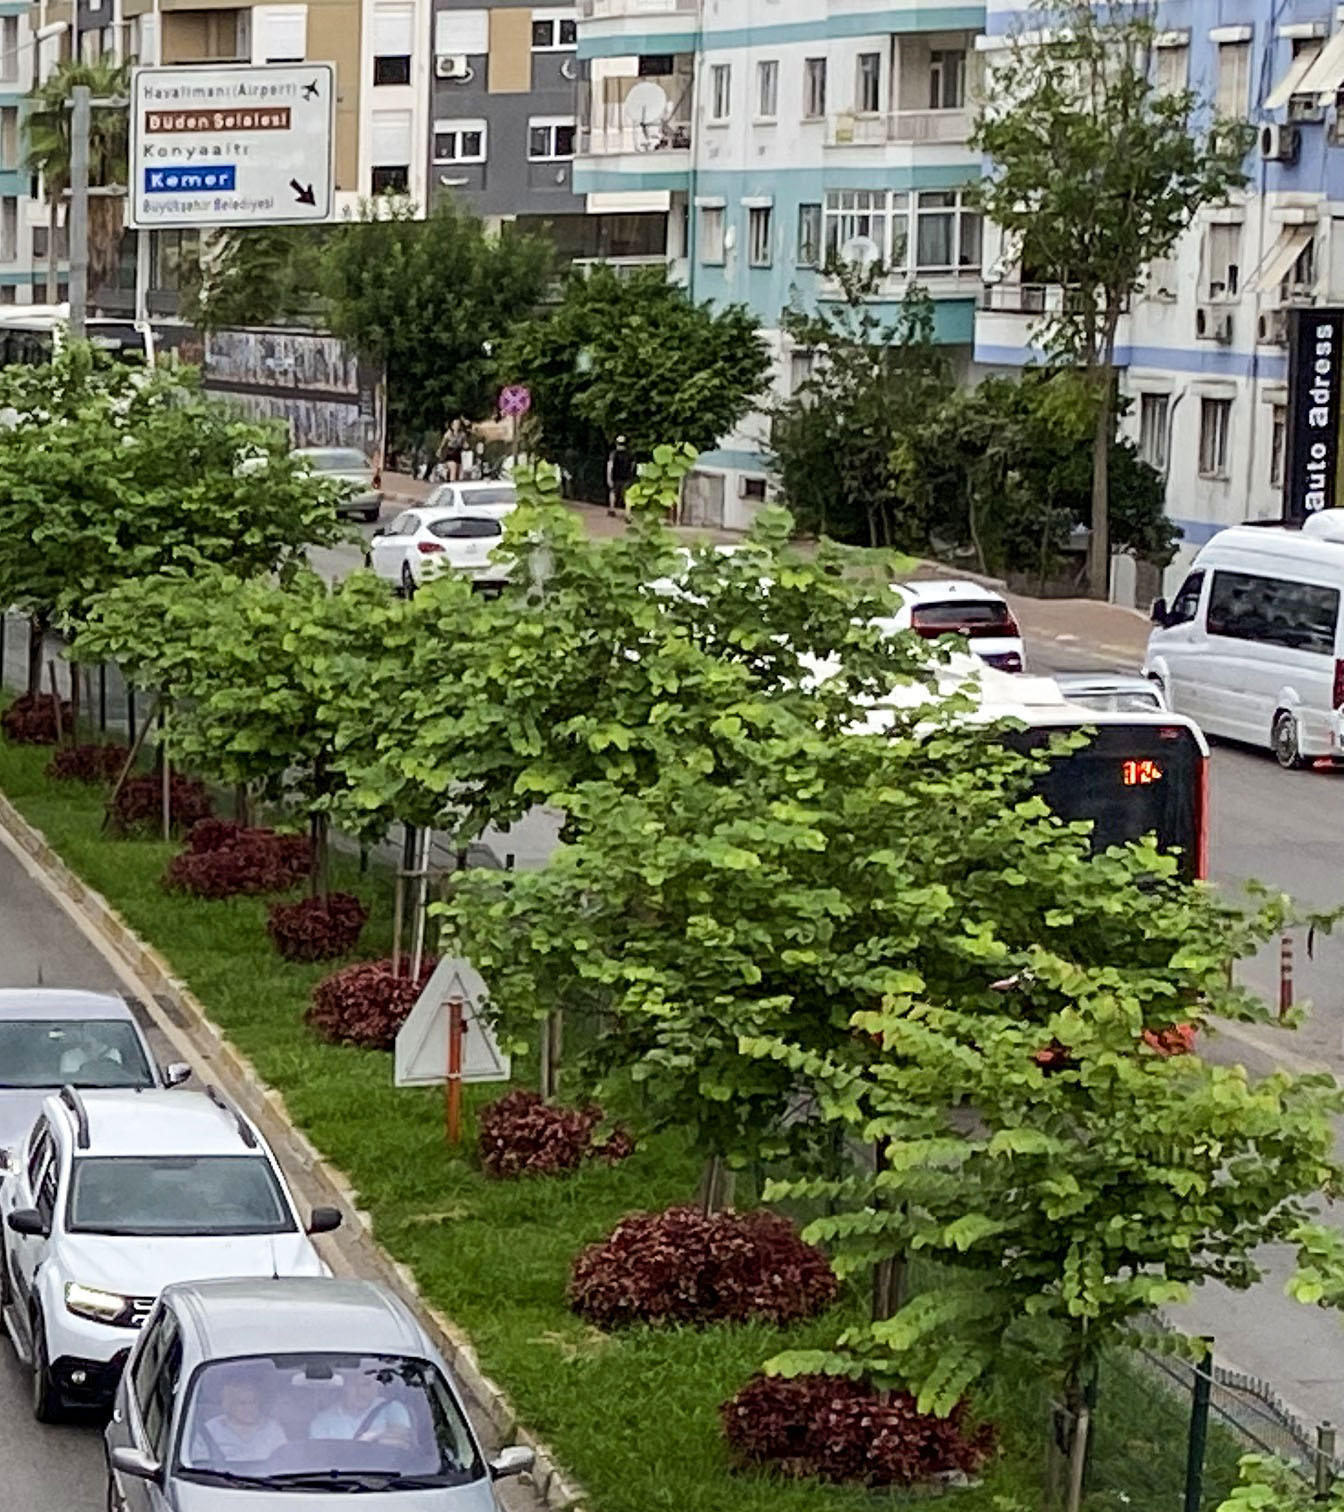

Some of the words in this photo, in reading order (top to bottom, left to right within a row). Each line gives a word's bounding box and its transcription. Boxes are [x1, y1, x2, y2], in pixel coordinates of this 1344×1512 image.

[151, 172, 228, 188] Kemer
[1308, 324, 1334, 427] adress
[1305, 442, 1327, 511] auto
